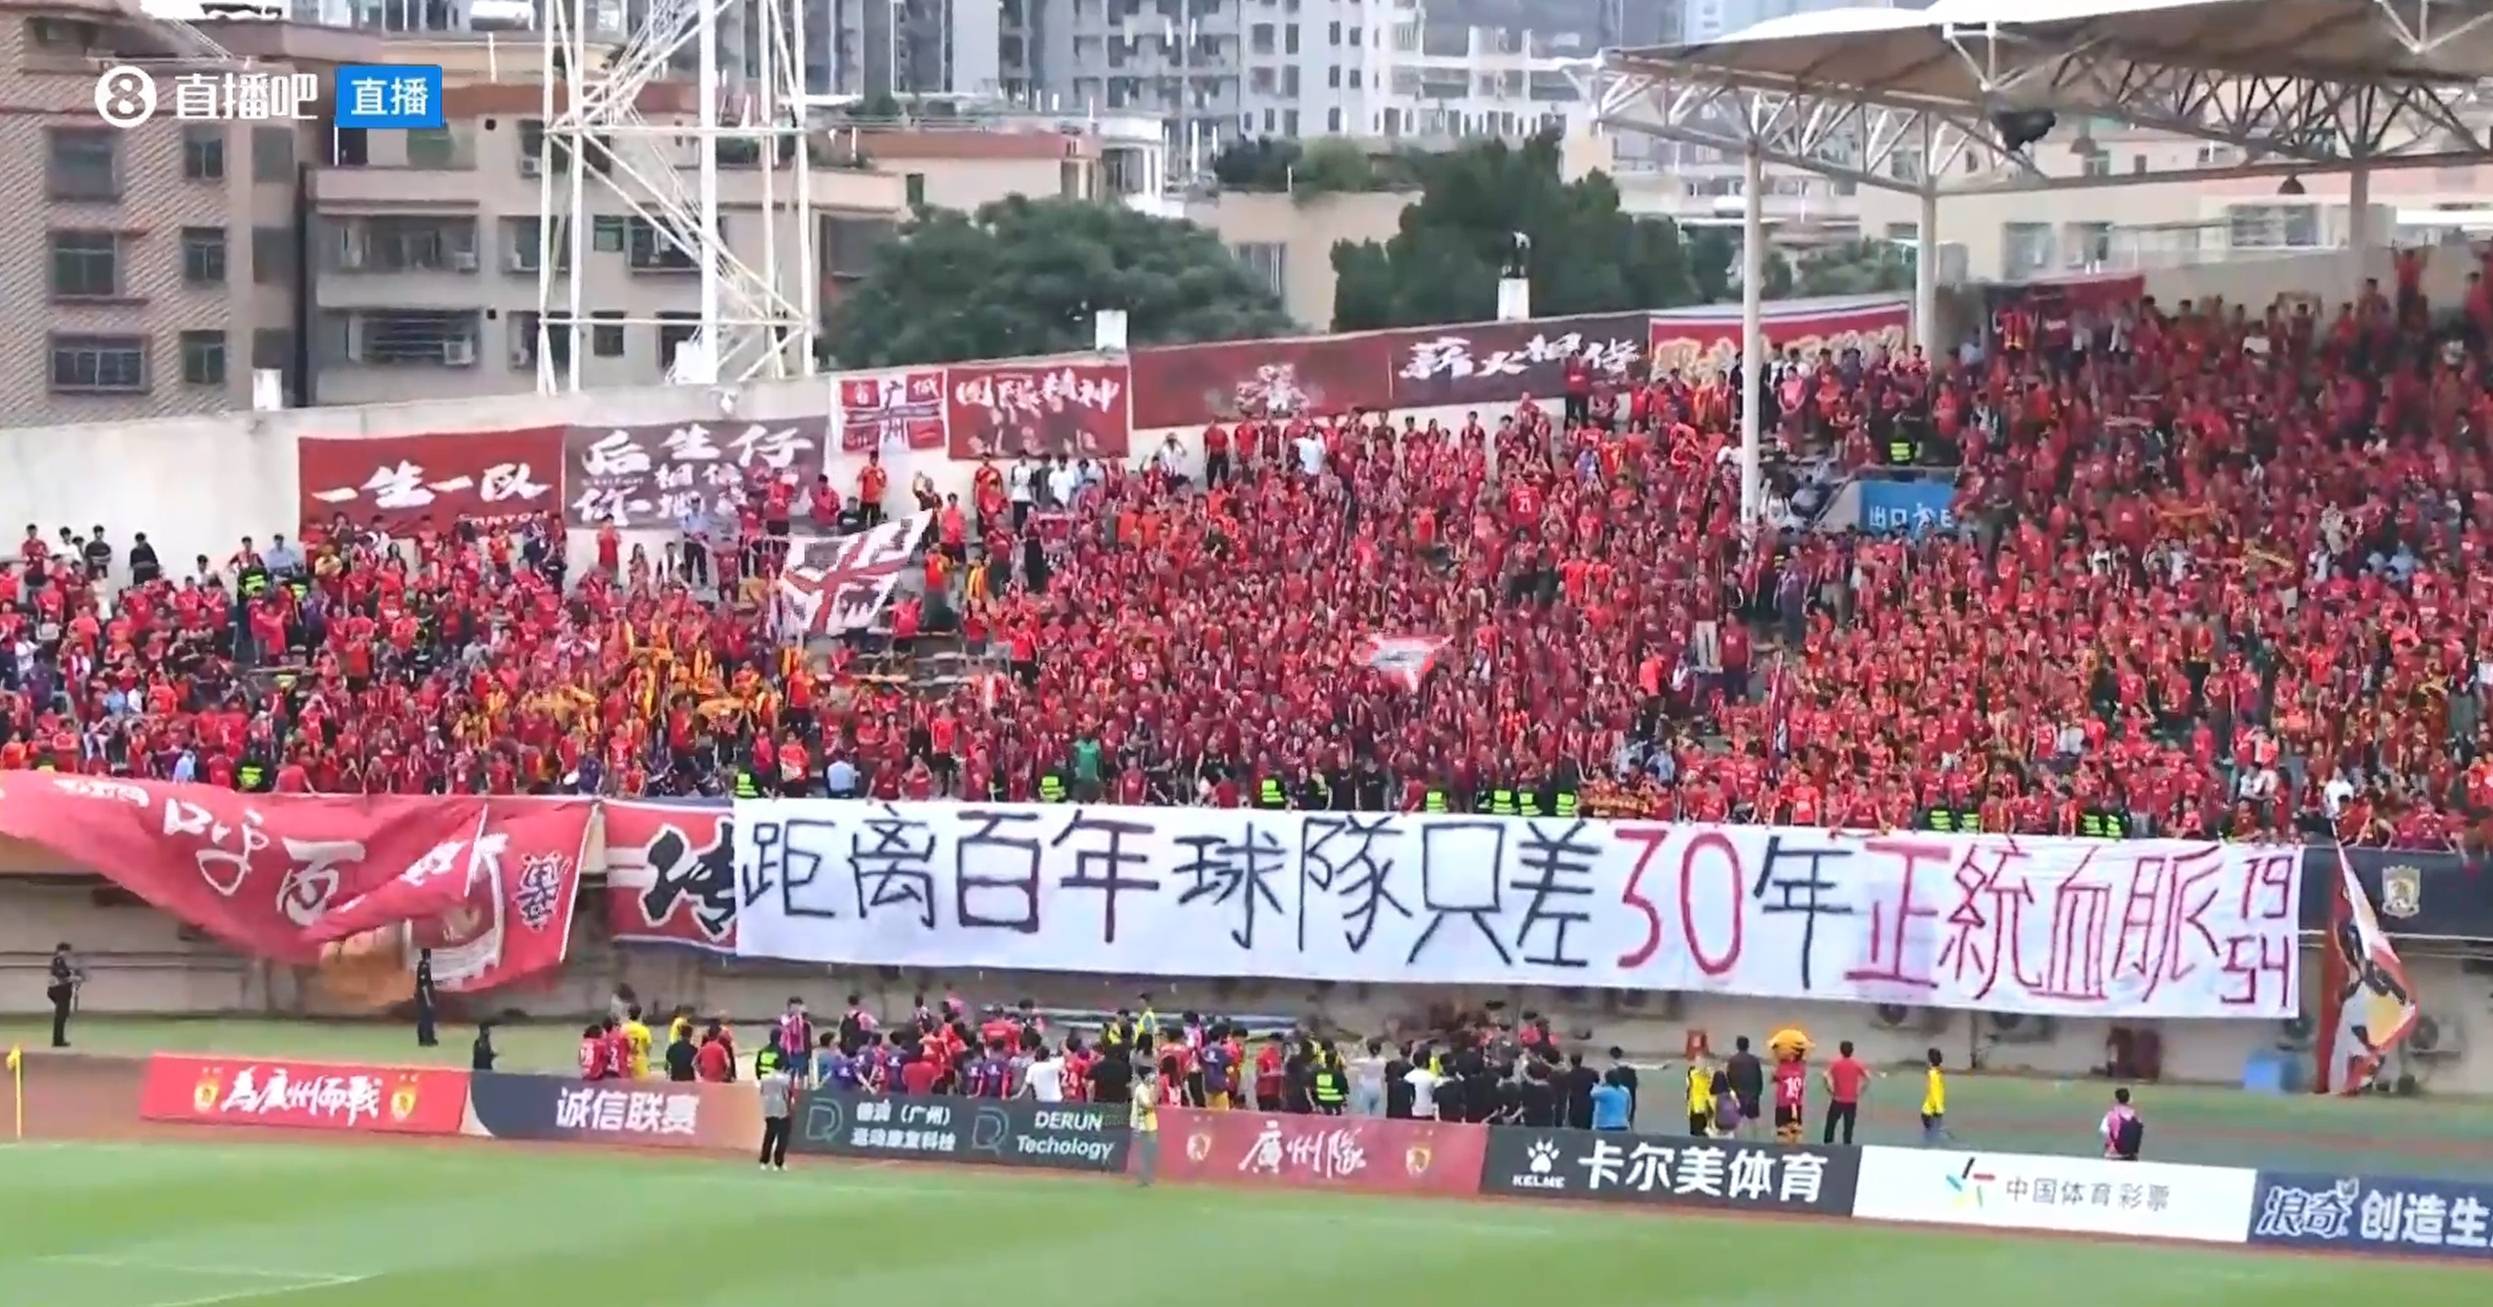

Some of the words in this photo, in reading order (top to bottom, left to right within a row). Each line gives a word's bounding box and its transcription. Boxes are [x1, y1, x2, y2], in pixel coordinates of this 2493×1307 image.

[581, 423, 816, 477] 后生仔
[311, 459, 553, 510] 一生一队
[1869, 505, 1908, 529] 出口
[556, 1087, 699, 1135] 诚信联赛
[1034, 1110, 1103, 1131] DERUN
[1016, 1136, 1116, 1161] Techology
[1578, 1139, 1829, 1203] 卡尔美体育
[1512, 1174, 1566, 1189] KELME
[2006, 1176, 2171, 1212] 中国体育彩票
[2255, 1184, 2354, 1240] 浪奇
[2360, 1189, 2493, 1249] 创造生
